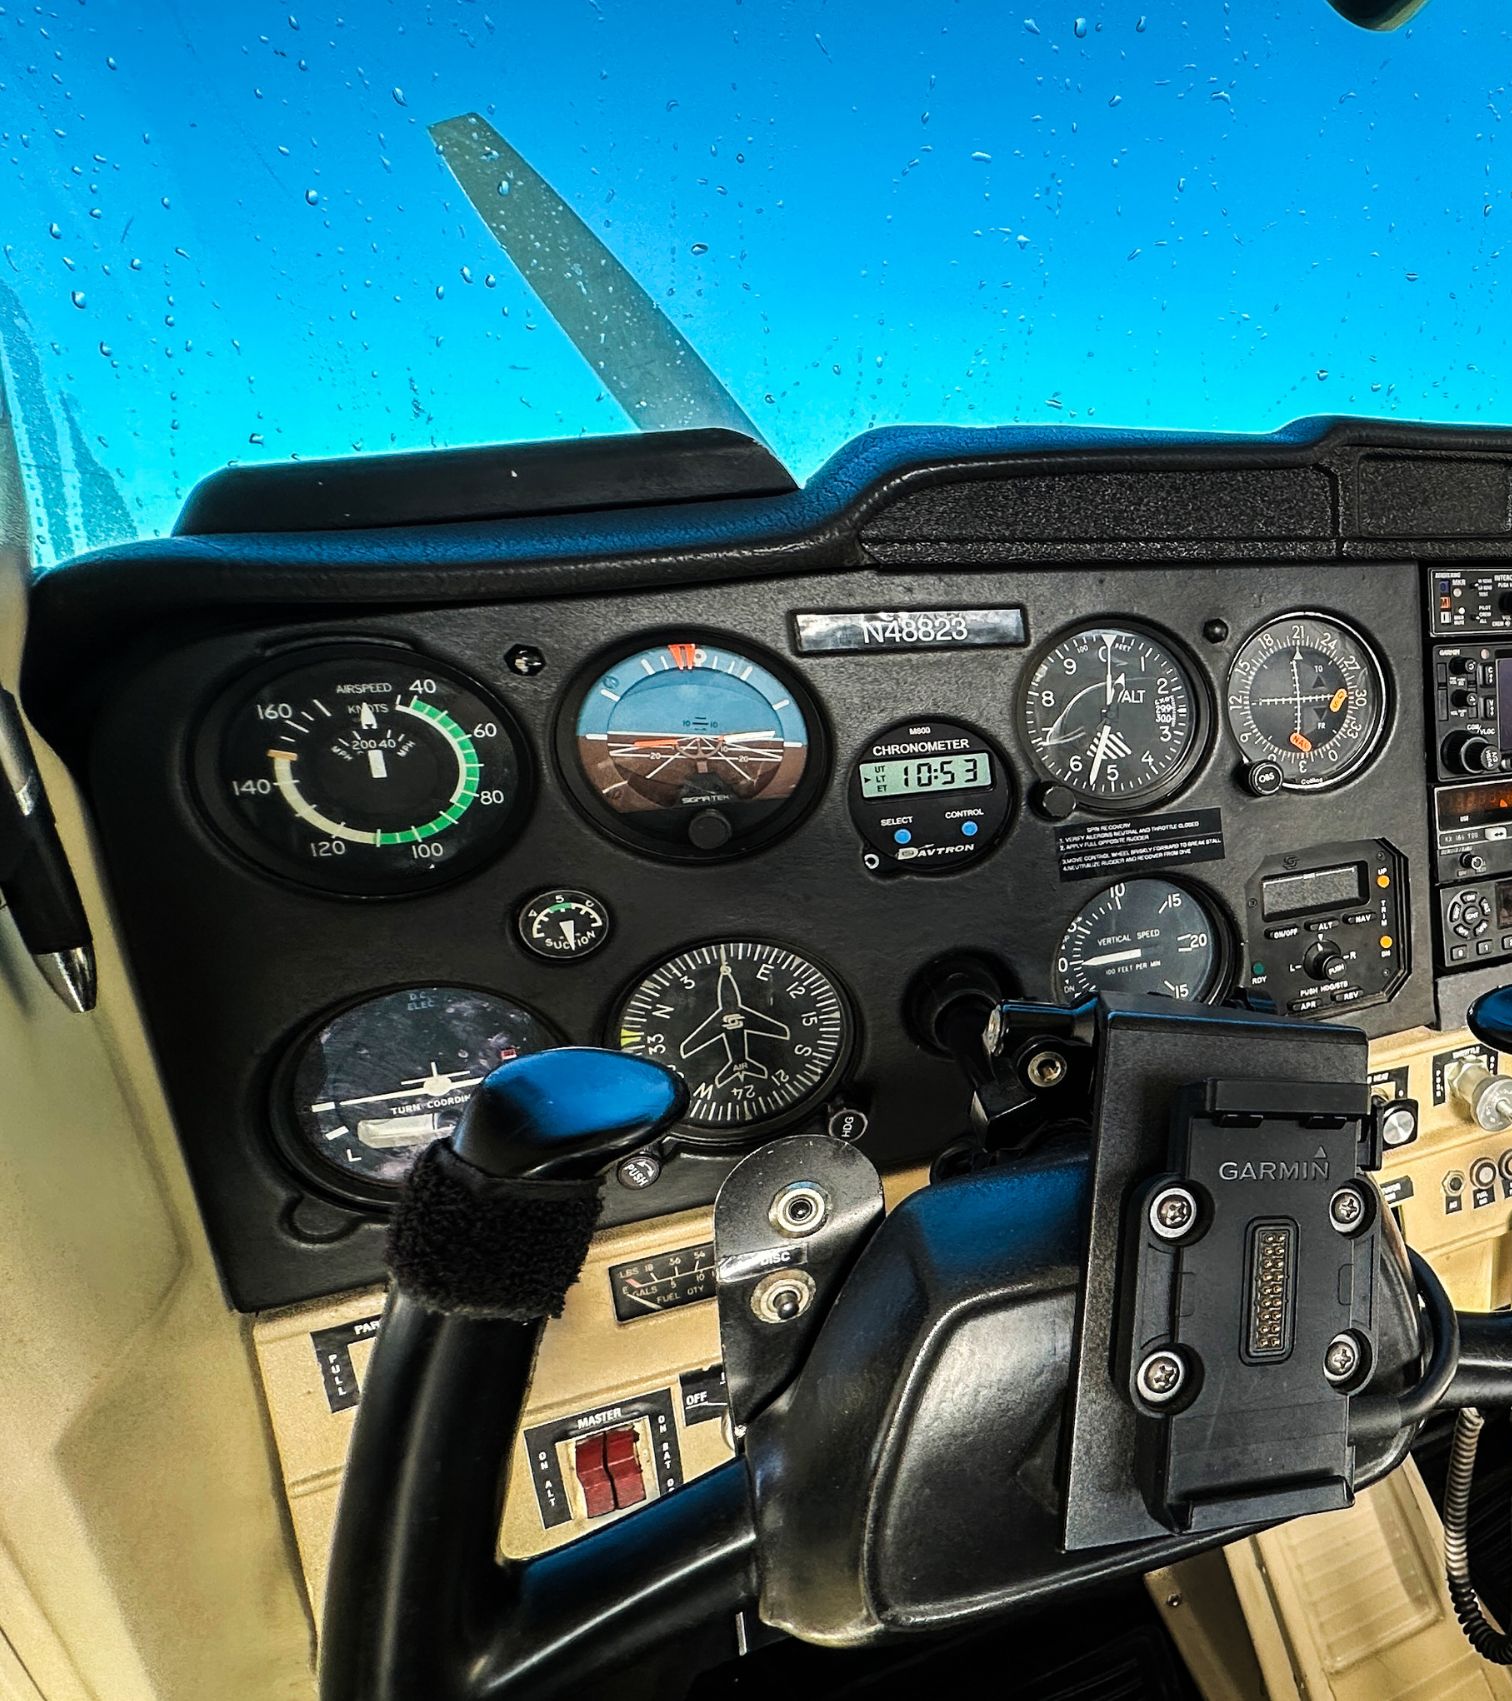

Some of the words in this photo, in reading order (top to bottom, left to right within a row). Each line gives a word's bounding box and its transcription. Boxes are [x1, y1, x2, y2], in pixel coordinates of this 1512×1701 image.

[863, 618, 968, 644] N48823
[1292, 626, 1304, 639] 21
[1258, 633, 1274, 648] 18
[1321, 633, 1337, 649] 24
[1063, 658, 1077, 675] 9
[1235, 661, 1250, 676] 15
[1344, 656, 1360, 670] 27
[336, 682, 392, 694] AIRSPEED
[409, 679, 436, 694] 40
[1157, 678, 1169, 695] 2
[1041, 690, 1054, 707] 8
[1121, 690, 1145, 703] ALT
[1355, 689, 1367, 706] 30
[257, 703, 292, 720] 160
[473, 722, 497, 738] 60
[1160, 726, 1172, 742] 3
[873, 738, 970, 756] CHRONOMETER
[1069, 756, 1082, 771] 6
[1141, 751, 1154, 765] 4
[903, 758, 978, 788] 10:53
[1107, 765, 1119, 781] 5
[232, 779, 271, 795] 140
[480, 790, 504, 805] 80
[881, 816, 913, 826] SELECT
[945, 808, 984, 819] CONTROL
[1100, 823, 1131, 831] RECOVERY
[1151, 823, 1177, 832] THROTTLE
[310, 841, 346, 857] 120
[412, 842, 443, 859] 100
[1110, 883, 1126, 898] 10
[1168, 893, 1182, 908] 15
[1318, 922, 1333, 930] ALT
[1355, 914, 1371, 924] NAV
[1097, 934, 1131, 946] VERTICAL
[1137, 929, 1160, 939] SPEED
[1190, 934, 1207, 948] 20
[756, 963, 775, 981] E
[1058, 957, 1068, 973] 0
[1252, 976, 1267, 984] RDY
[786, 981, 806, 999] 12
[1175, 984, 1189, 999] 15
[1300, 987, 1318, 996] PUSH
[652, 1004, 674, 1019] N
[1301, 1001, 1316, 1010] APR
[801, 1012, 818, 1027] 15
[391, 1103, 420, 1116] TURN
[624, 1163, 649, 1186] PUSH
[1218, 1161, 1330, 1181] GARMIN
[620, 1267, 639, 1278] LBS
[656, 1293, 680, 1303] FUEL
[328, 1354, 347, 1396] PULL
[686, 1391, 707, 1406] OFF
[577, 1407, 622, 1430] MASTER
